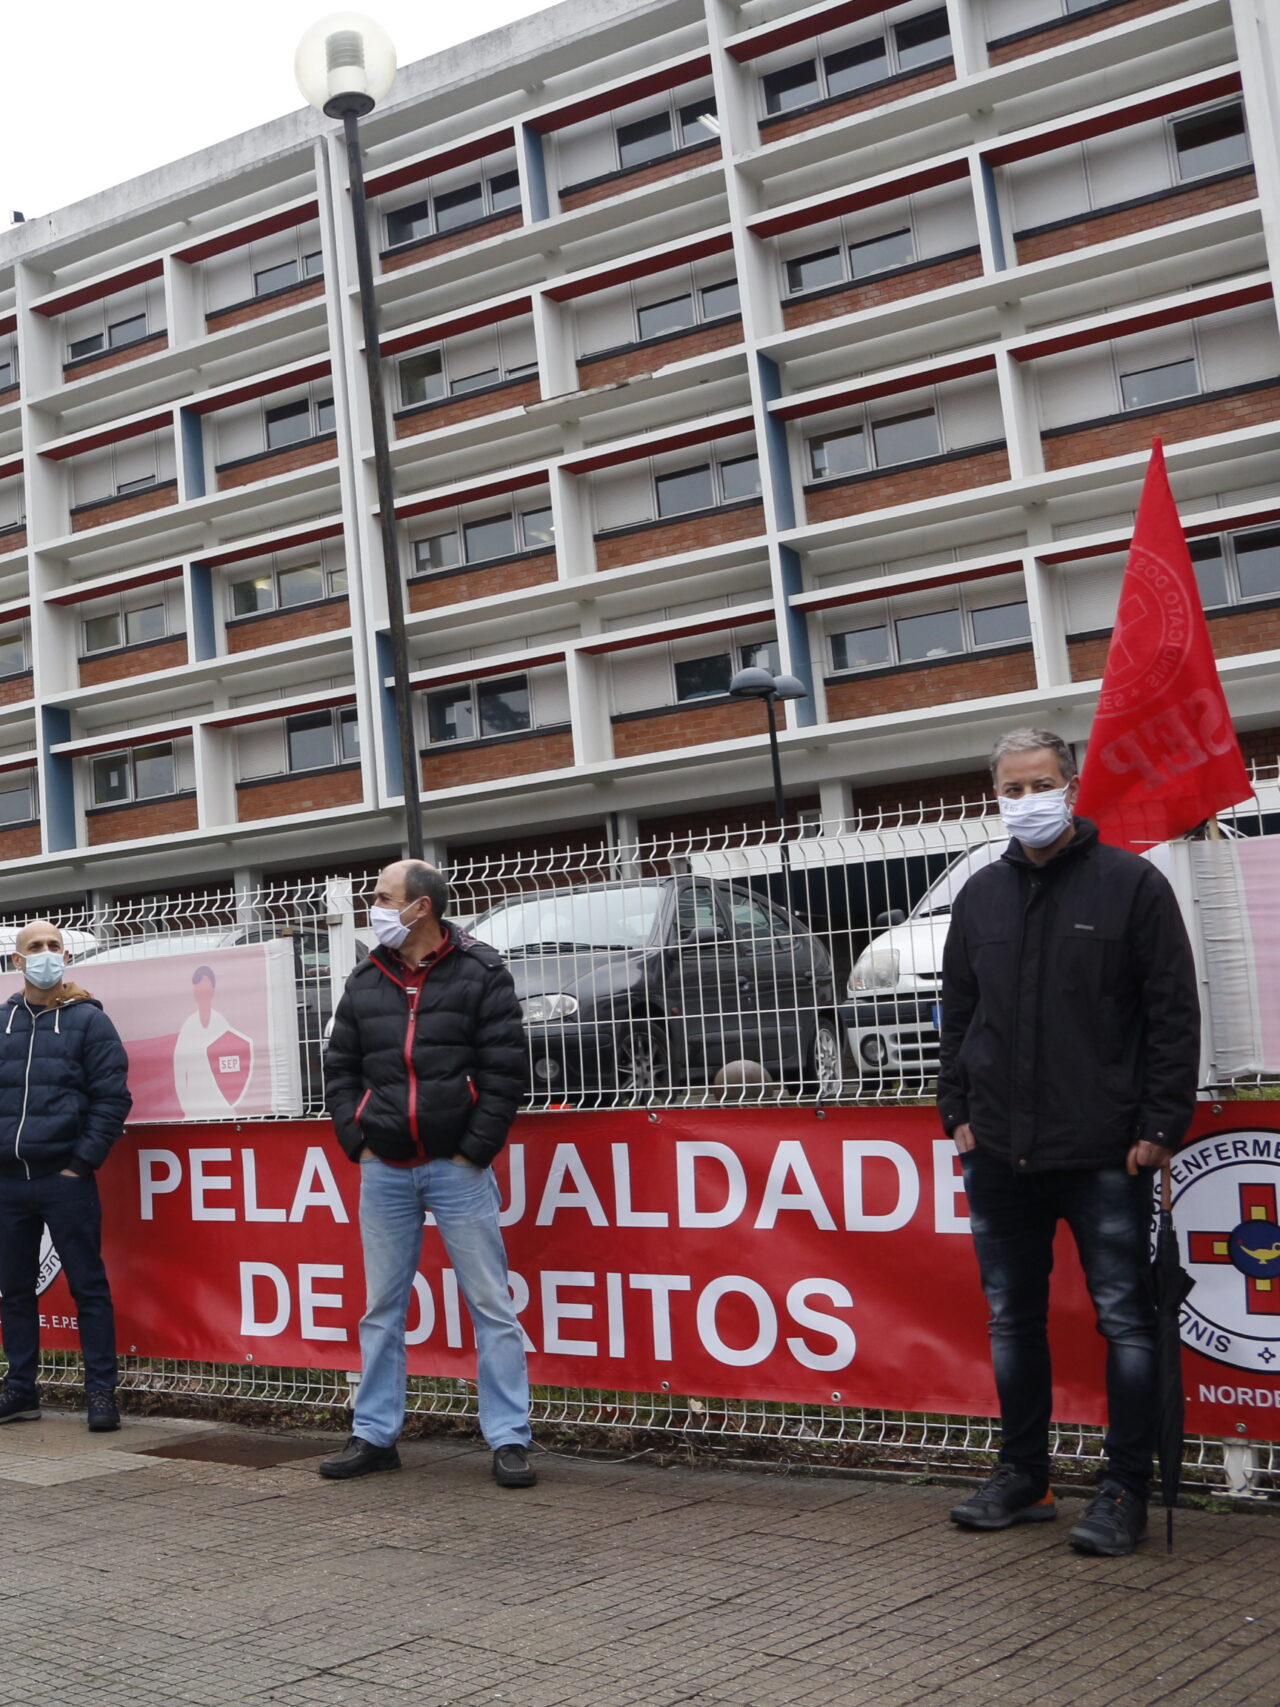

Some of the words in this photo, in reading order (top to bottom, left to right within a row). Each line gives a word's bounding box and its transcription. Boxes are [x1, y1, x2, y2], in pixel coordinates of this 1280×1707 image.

[221, 1058, 238, 1070] SEP
[138, 1147, 349, 1223] PELA
[239, 1261, 348, 1342] DE
